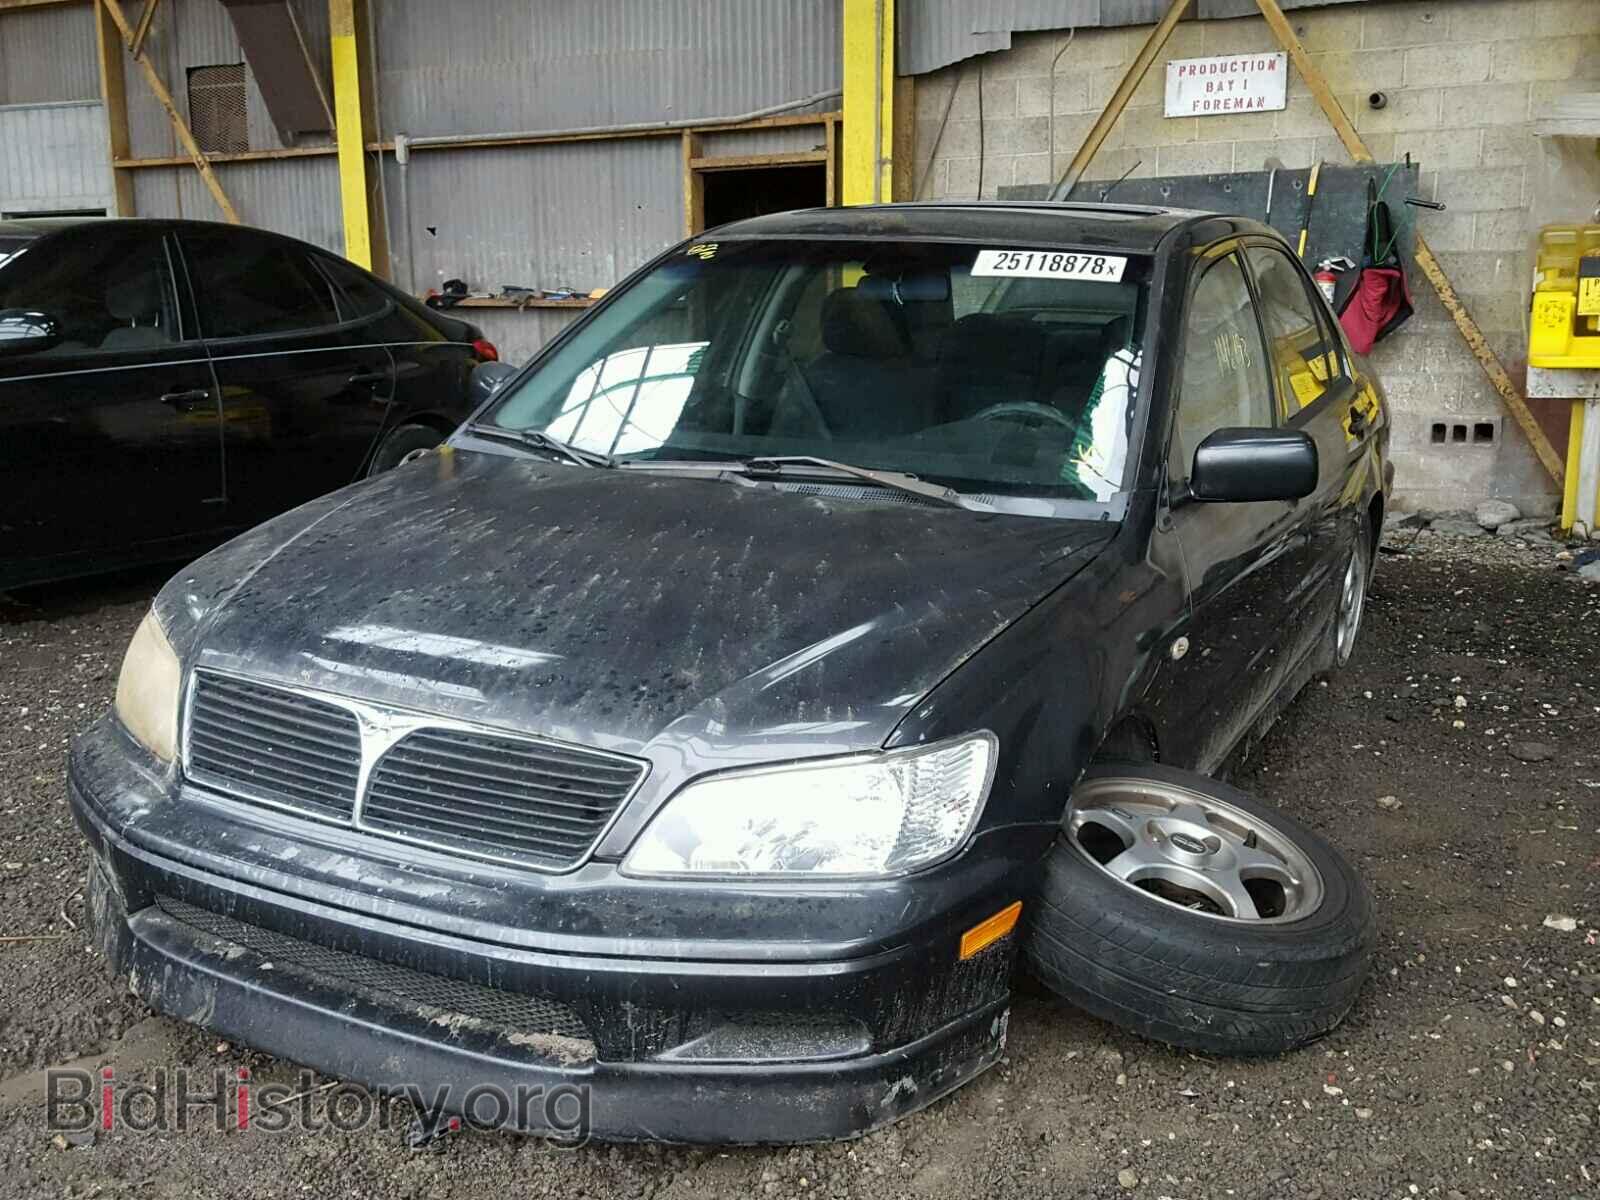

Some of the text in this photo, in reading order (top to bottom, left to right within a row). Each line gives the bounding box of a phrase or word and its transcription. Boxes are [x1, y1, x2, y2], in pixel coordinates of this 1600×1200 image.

[1178, 59, 1277, 77] PRODUCTION
[1206, 80, 1235, 93] BAY
[1192, 97, 1265, 112] FOREMAN
